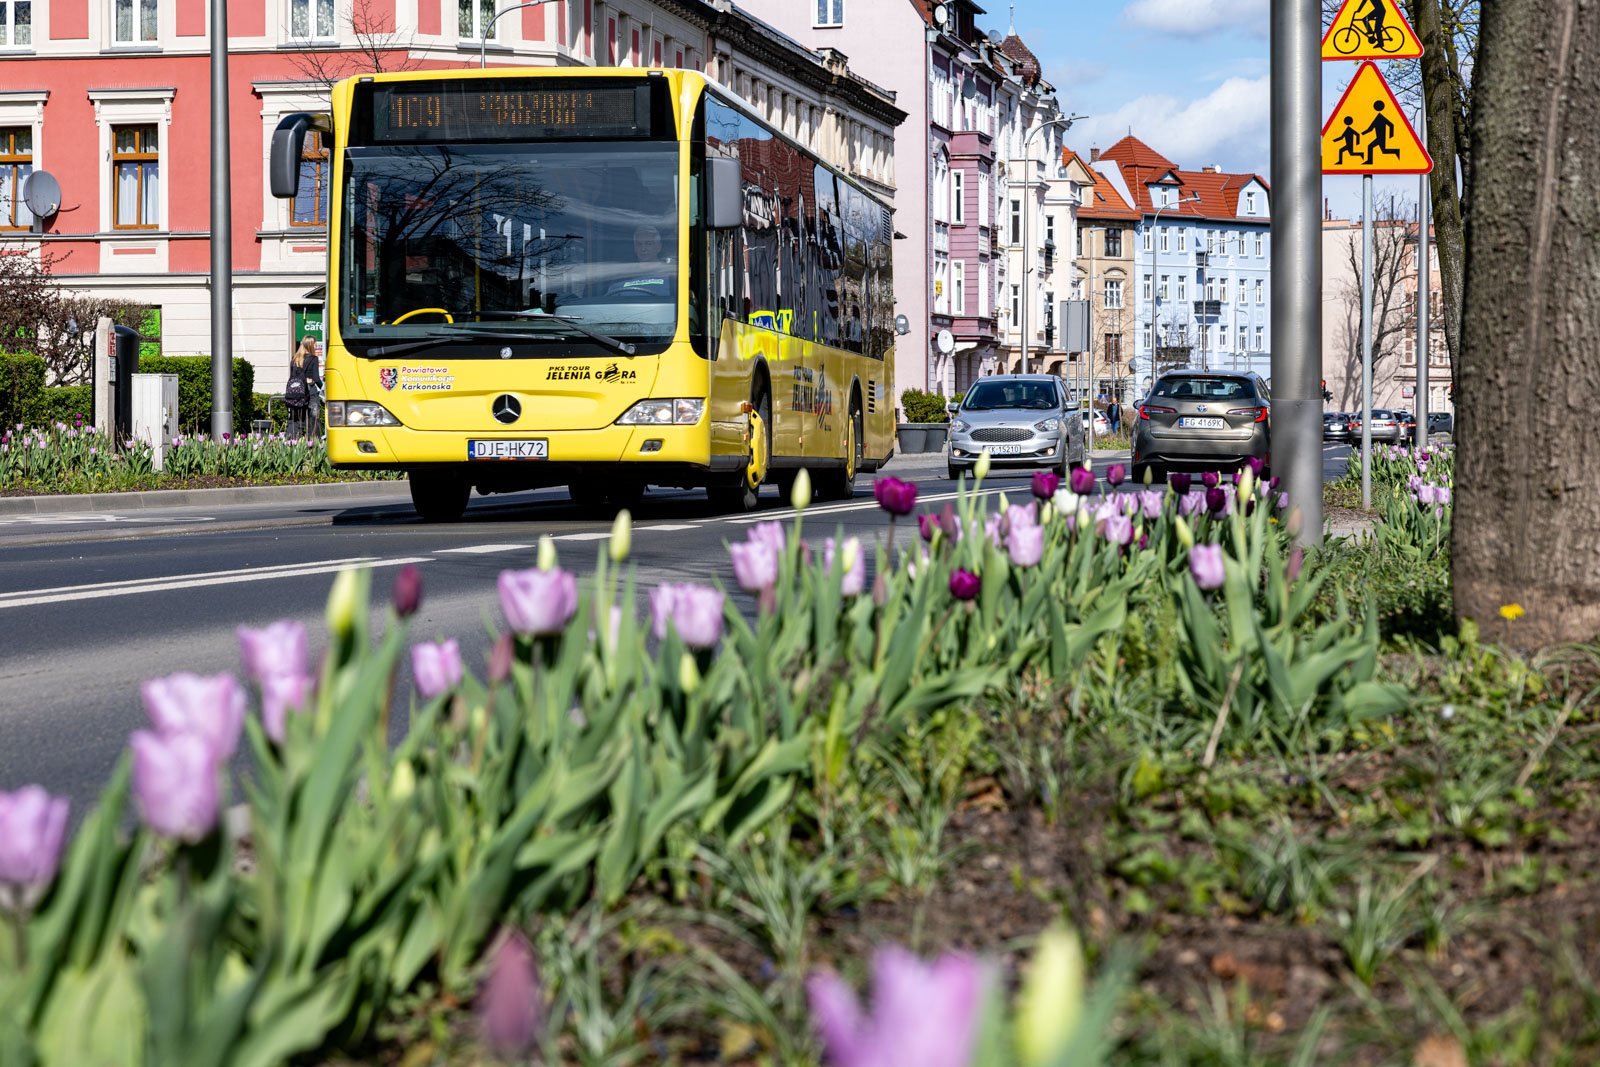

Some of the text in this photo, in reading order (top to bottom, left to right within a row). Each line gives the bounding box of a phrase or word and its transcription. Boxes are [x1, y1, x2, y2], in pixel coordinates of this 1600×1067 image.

[401, 366, 448, 374] Powiatowa
[401, 374, 455, 383] Komunikacja
[546, 371, 591, 380] JELENIA
[1184, 418, 1222, 427] FG 4169K
[477, 442, 544, 456] DJE HK72
